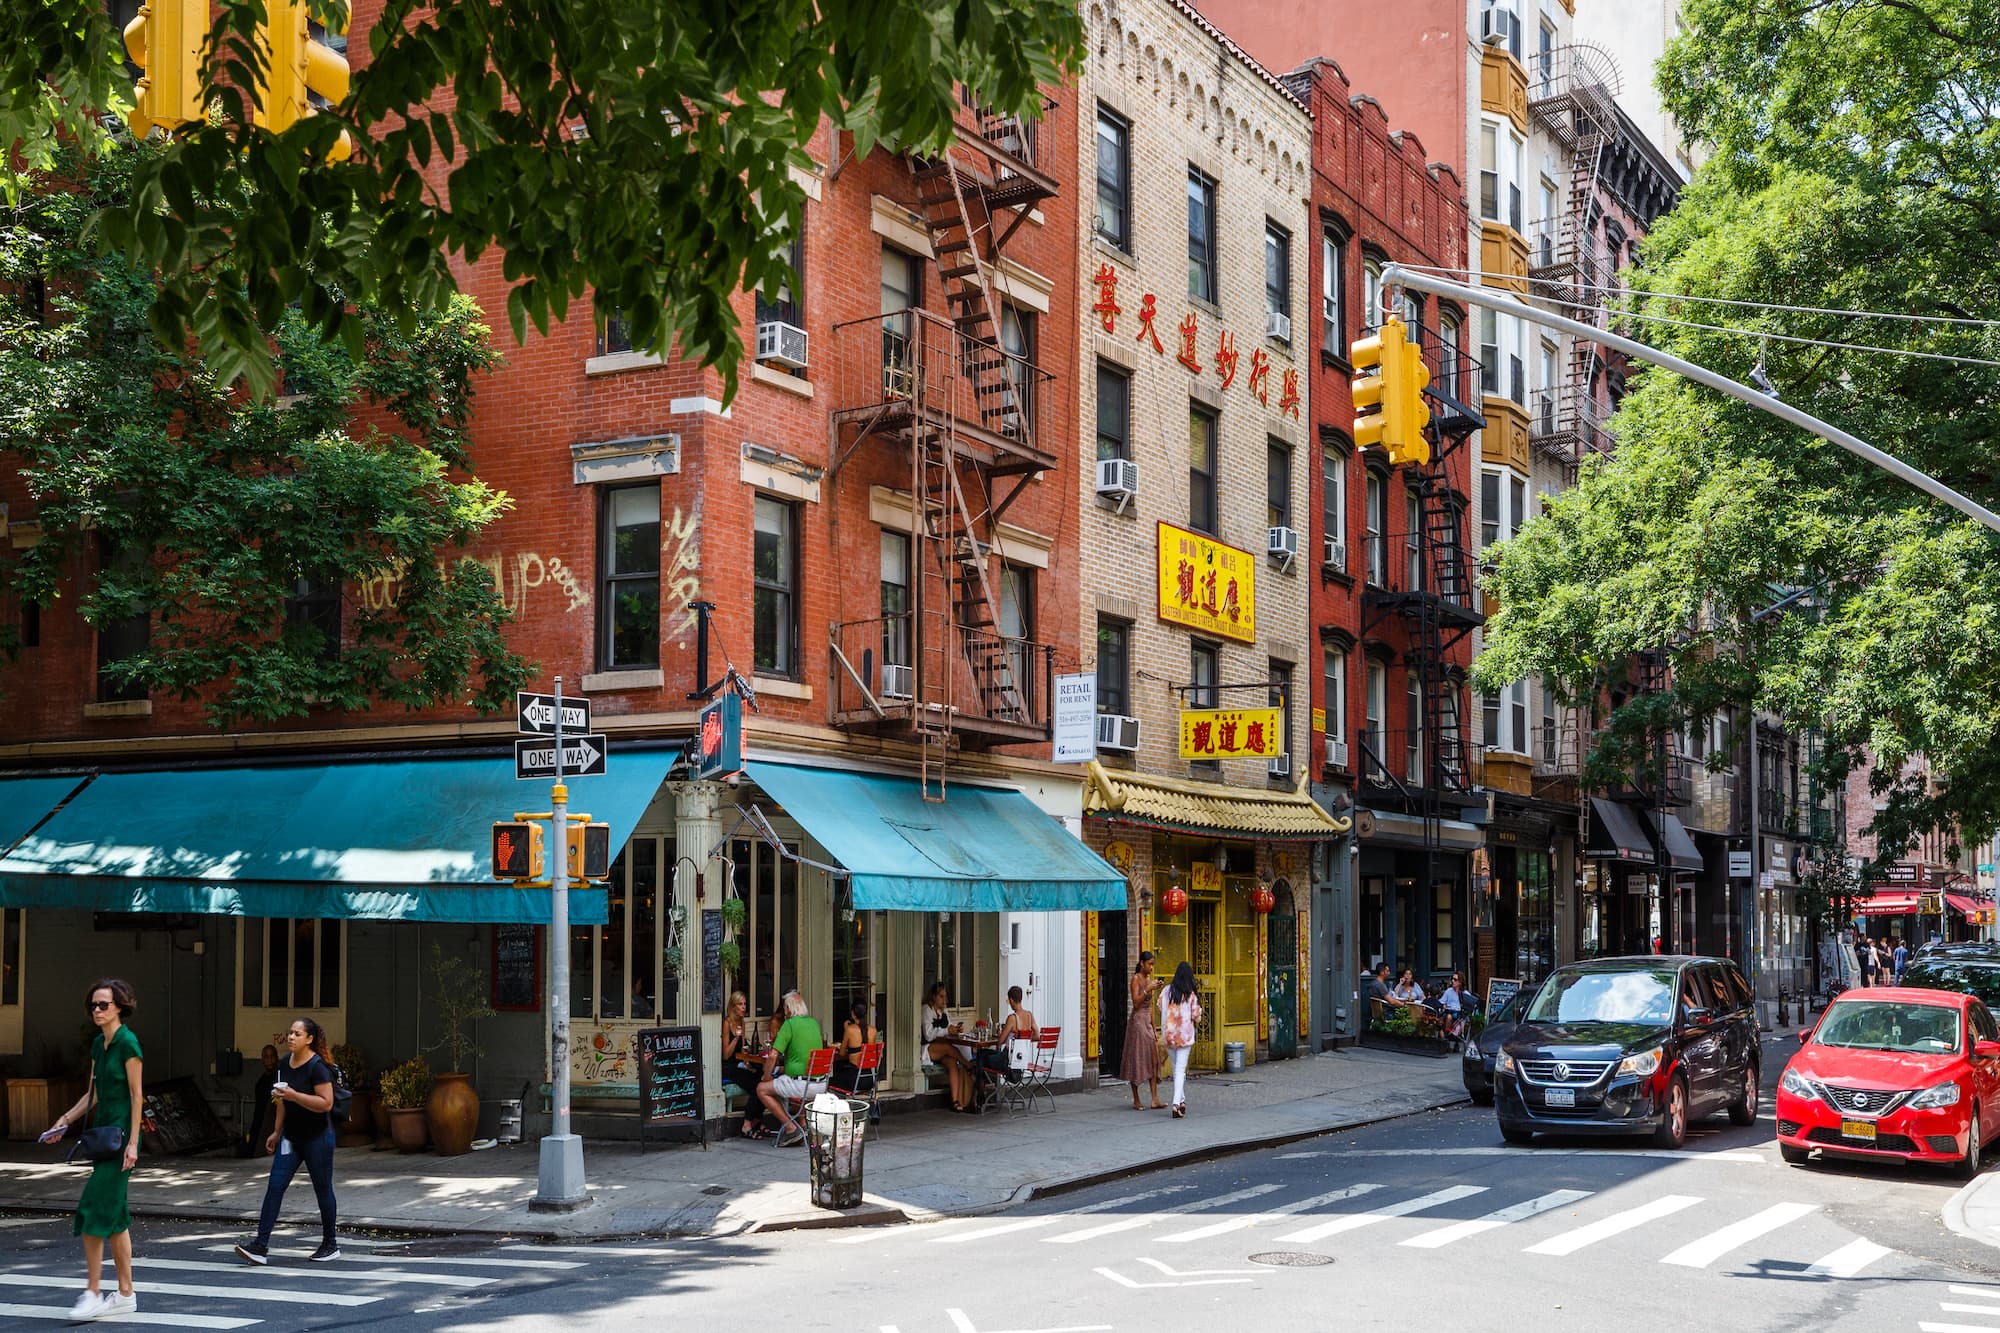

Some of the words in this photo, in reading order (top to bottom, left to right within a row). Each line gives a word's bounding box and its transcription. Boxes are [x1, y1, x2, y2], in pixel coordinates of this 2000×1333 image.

[1162, 604, 1181, 619] EASTERN
[1183, 609, 1197, 624] UNITED
[1198, 613, 1213, 627] STATES
[1060, 684, 1091, 695] RETAIL
[1060, 696, 1073, 704] FOR
[1074, 695, 1091, 703] RENT
[530, 706, 551, 722] ONE
[561, 709, 581, 724] WAY
[529, 751, 554, 767] ONE
[566, 748, 592, 765] WAY
